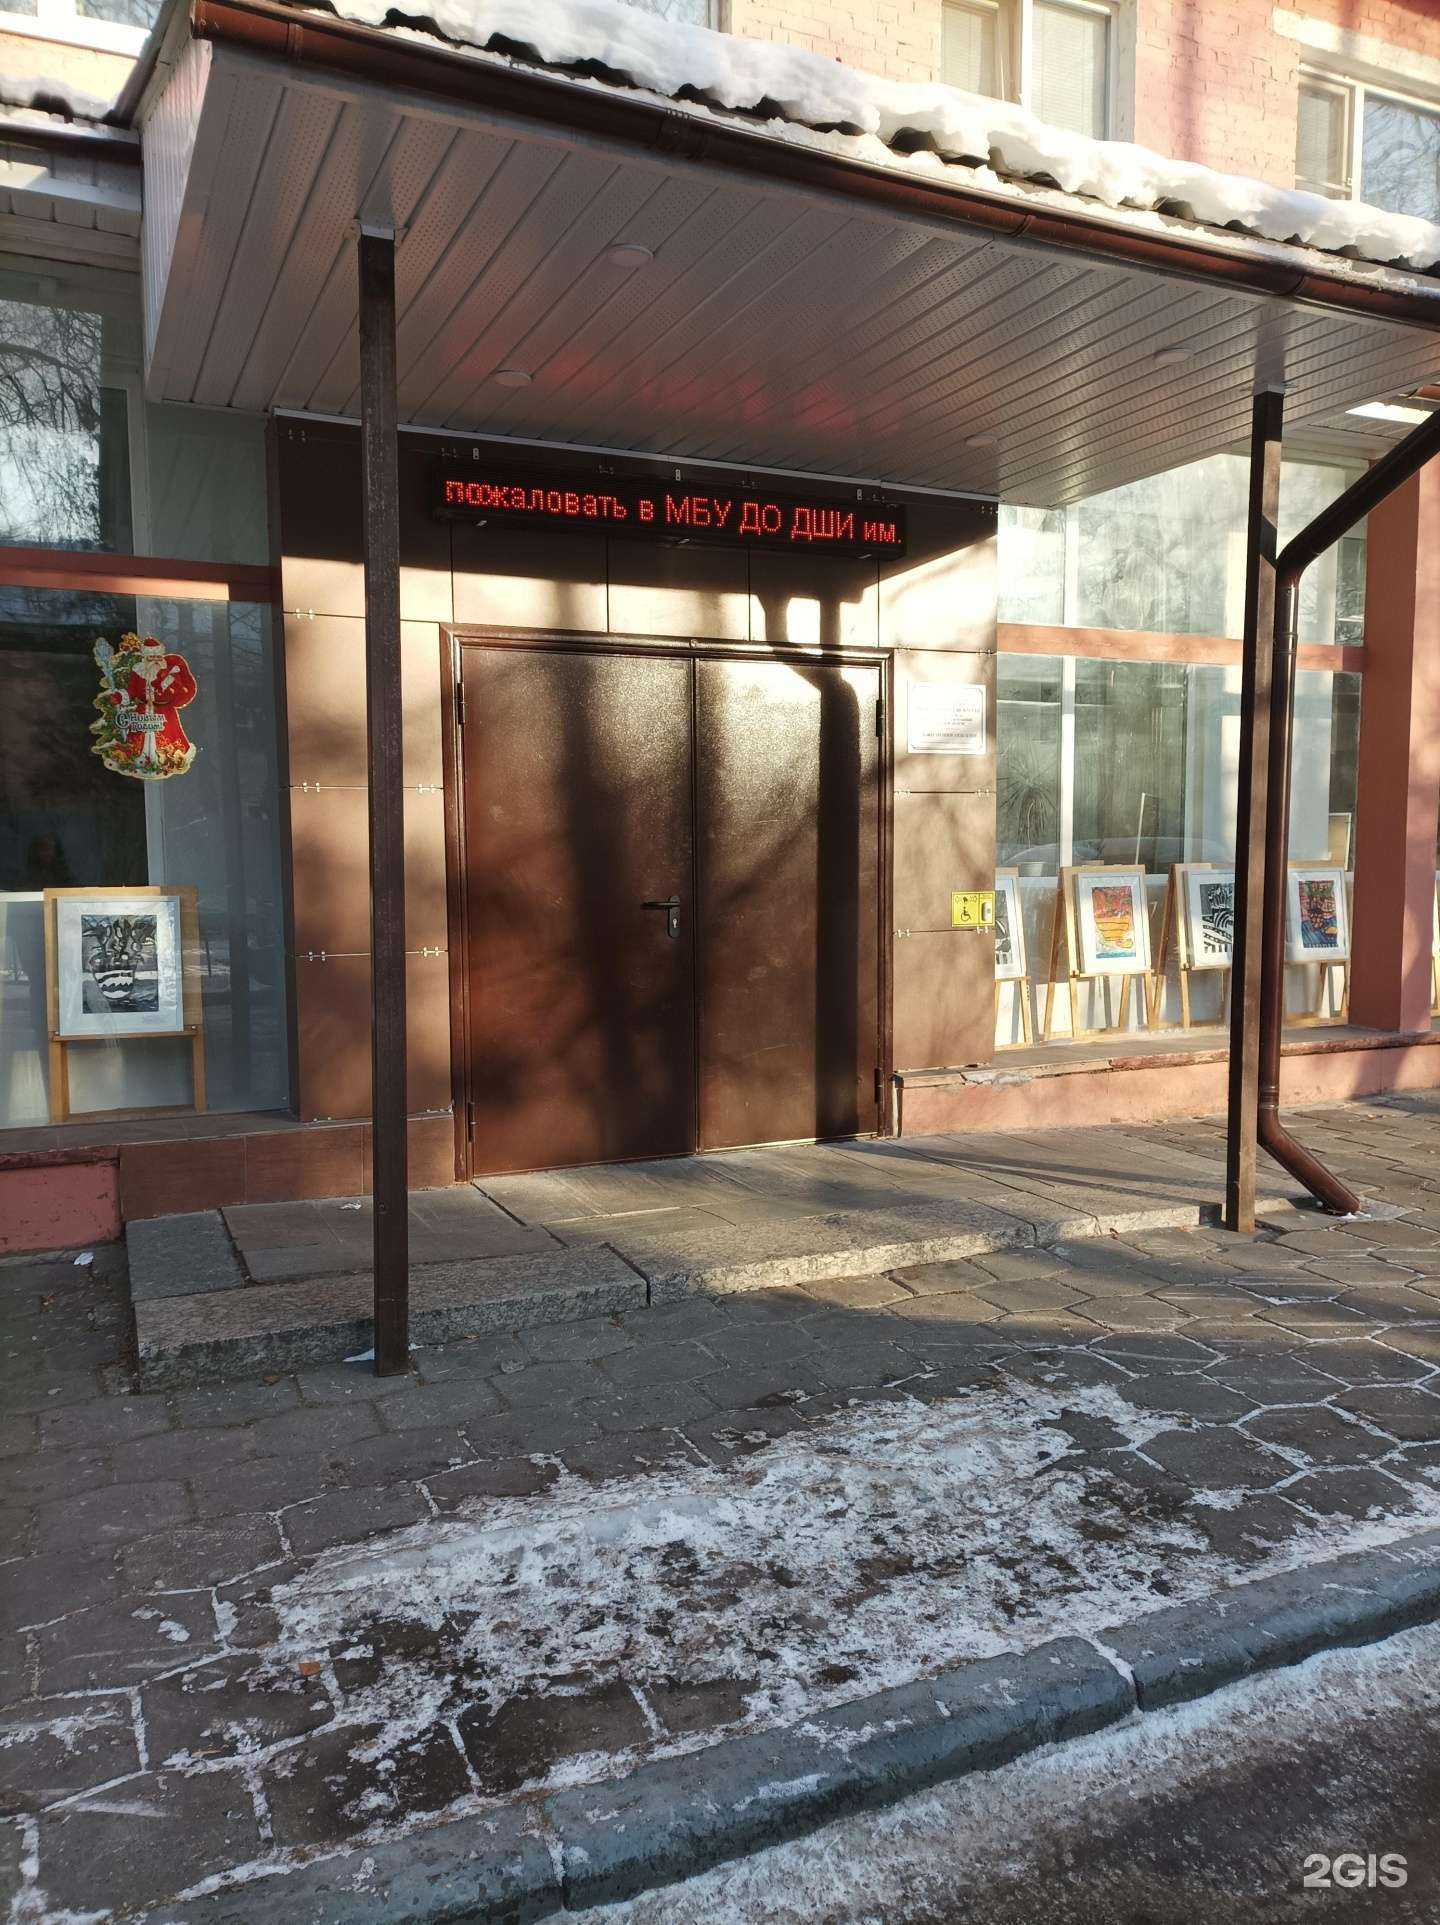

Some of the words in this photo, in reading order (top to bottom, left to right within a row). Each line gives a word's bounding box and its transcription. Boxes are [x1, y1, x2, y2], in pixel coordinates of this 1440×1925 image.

[446, 480, 628, 519] пожаловать
[639, 499, 654, 521] в
[665, 494, 732, 528] МБУ
[739, 502, 782, 536] ДО
[790, 507, 854, 541] ДШИ
[863, 520, 902, 544] им.
